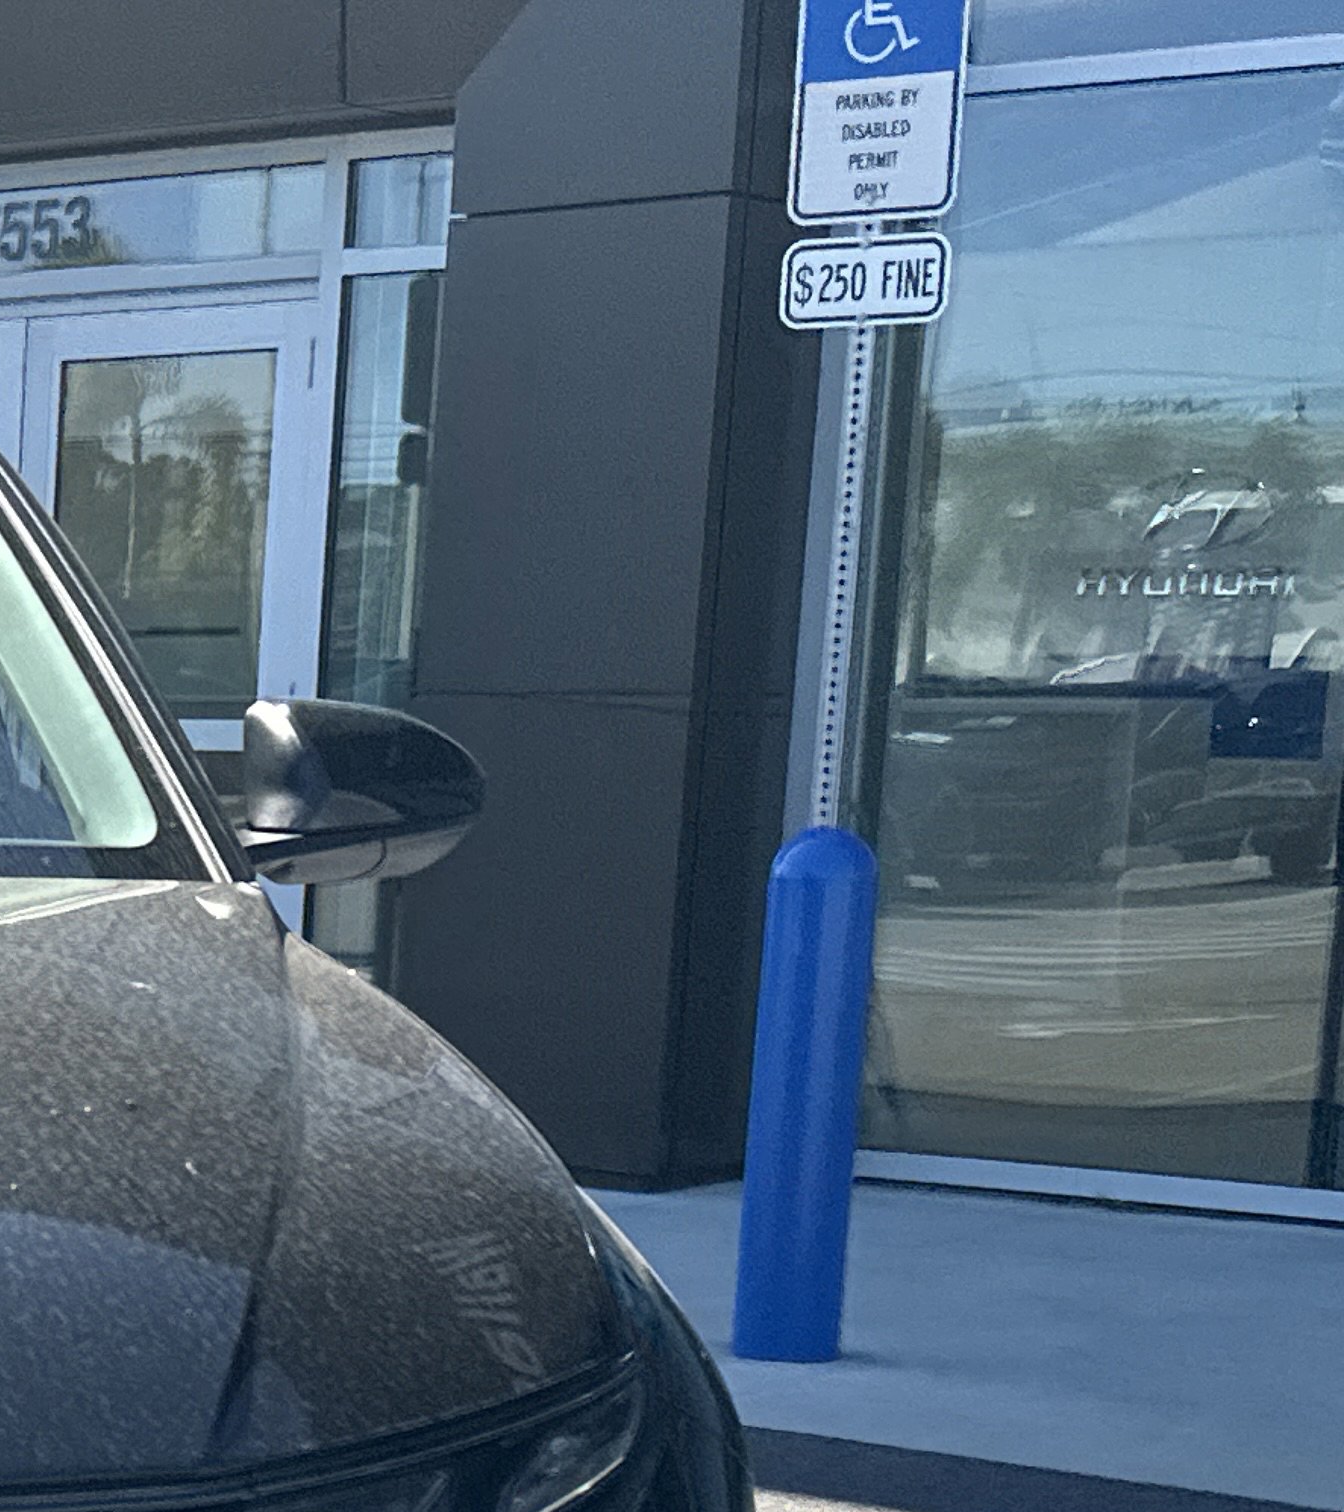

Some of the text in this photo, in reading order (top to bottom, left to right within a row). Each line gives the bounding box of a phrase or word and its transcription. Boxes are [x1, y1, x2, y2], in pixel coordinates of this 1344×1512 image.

[835, 88, 919, 112] PARKING BY
[841, 119, 911, 142] DISABLED
[848, 150, 899, 171] PERMIT
[853, 182, 889, 201] ONLY
[793, 257, 936, 308] $250 FINE
